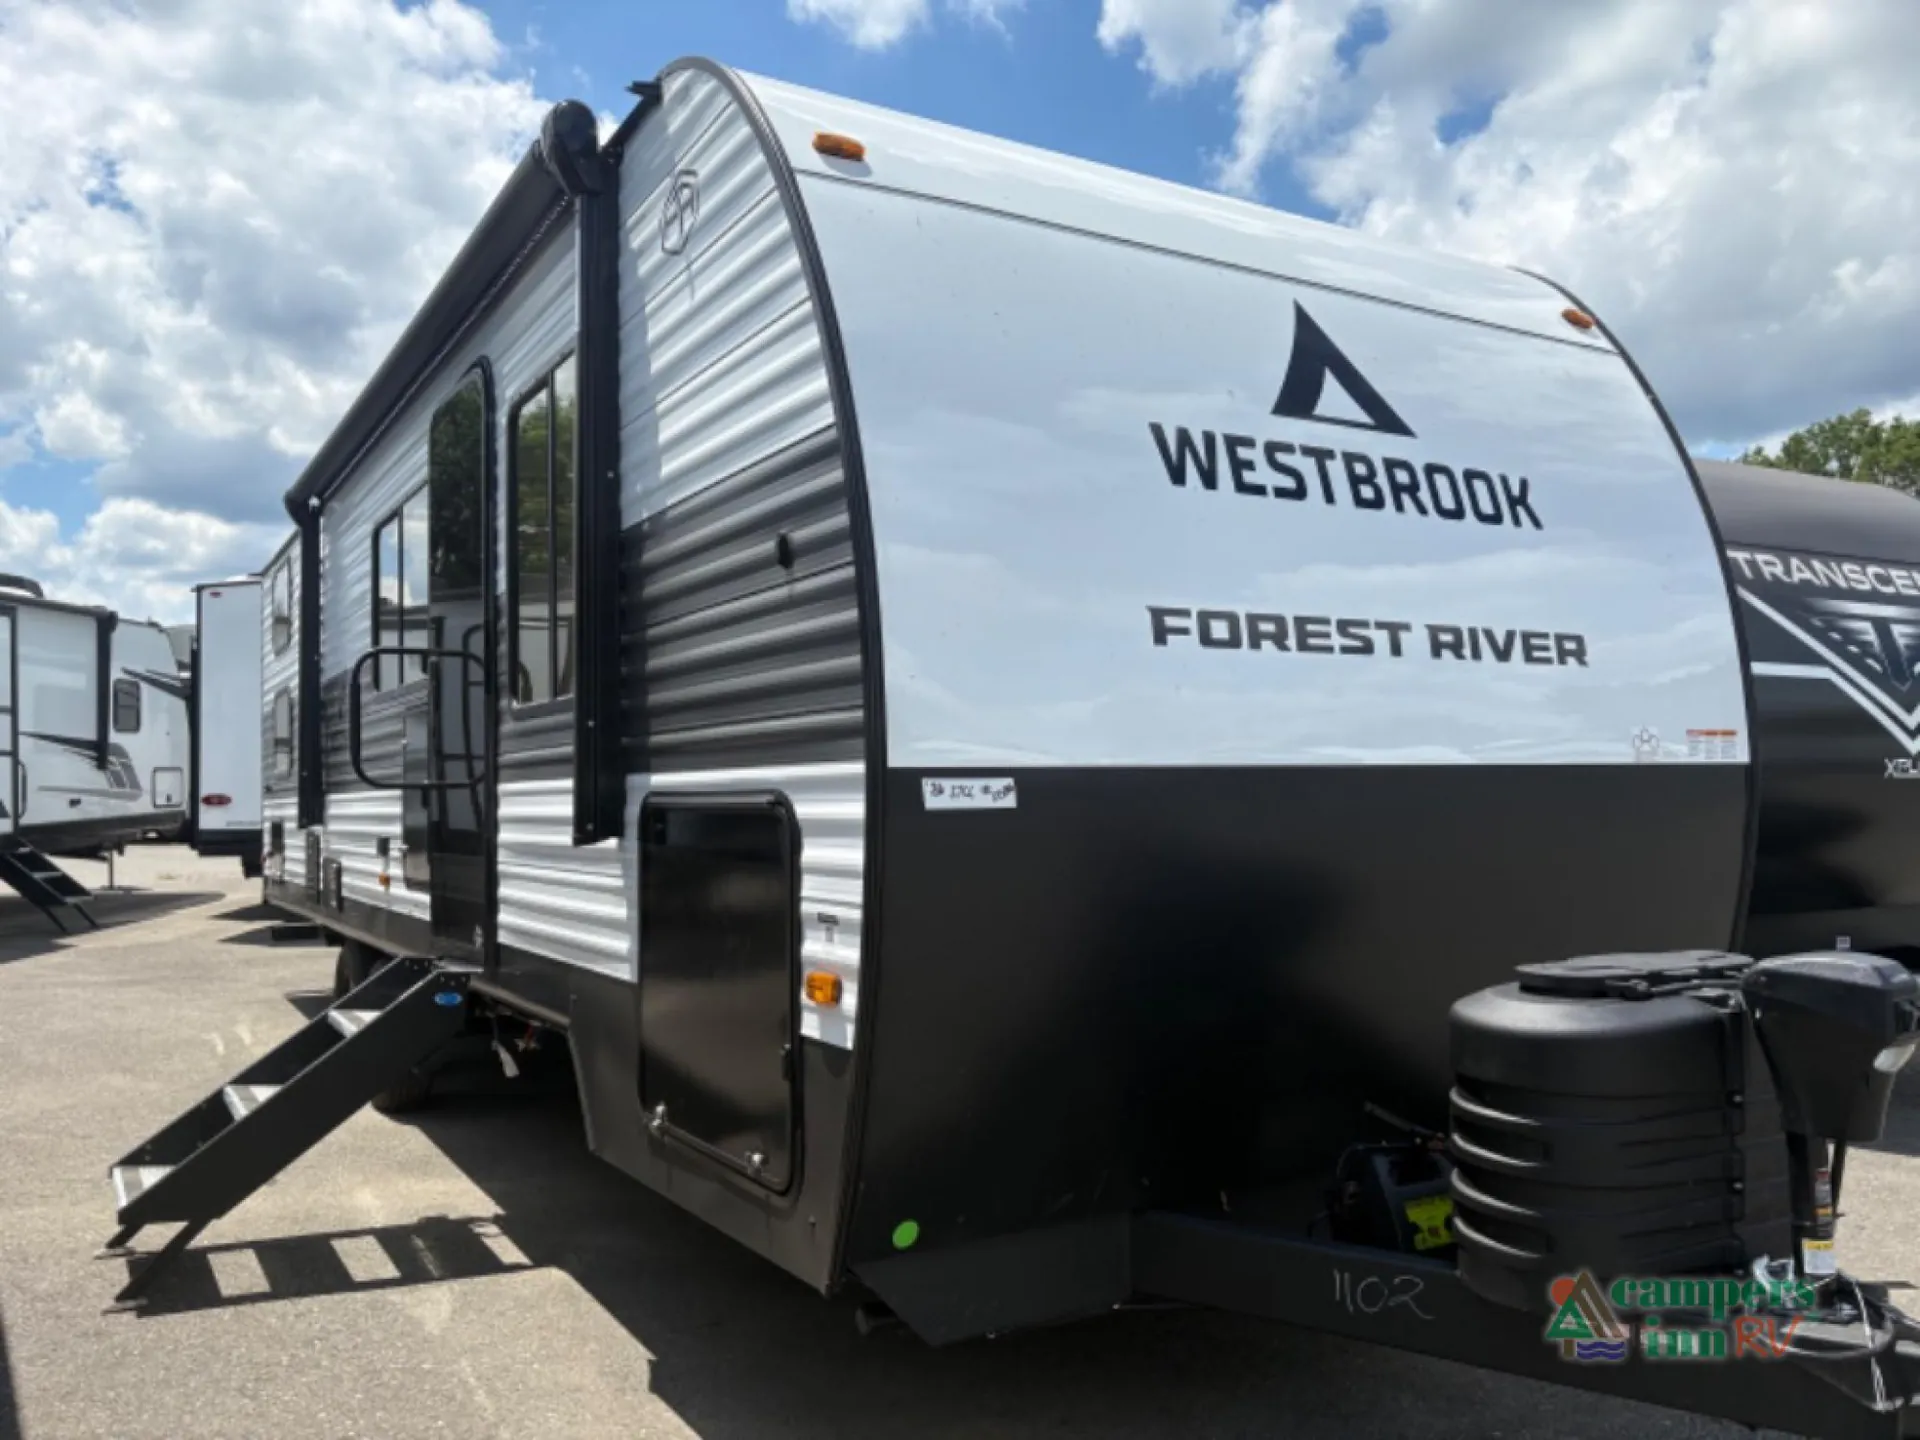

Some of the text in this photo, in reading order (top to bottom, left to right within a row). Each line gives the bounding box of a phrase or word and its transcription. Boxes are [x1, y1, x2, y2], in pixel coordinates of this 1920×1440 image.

[1149, 422, 1543, 530] WESTBROOK
[1146, 605, 1589, 667] FOREST RIVER
[1333, 1268, 1436, 1319] 1102
